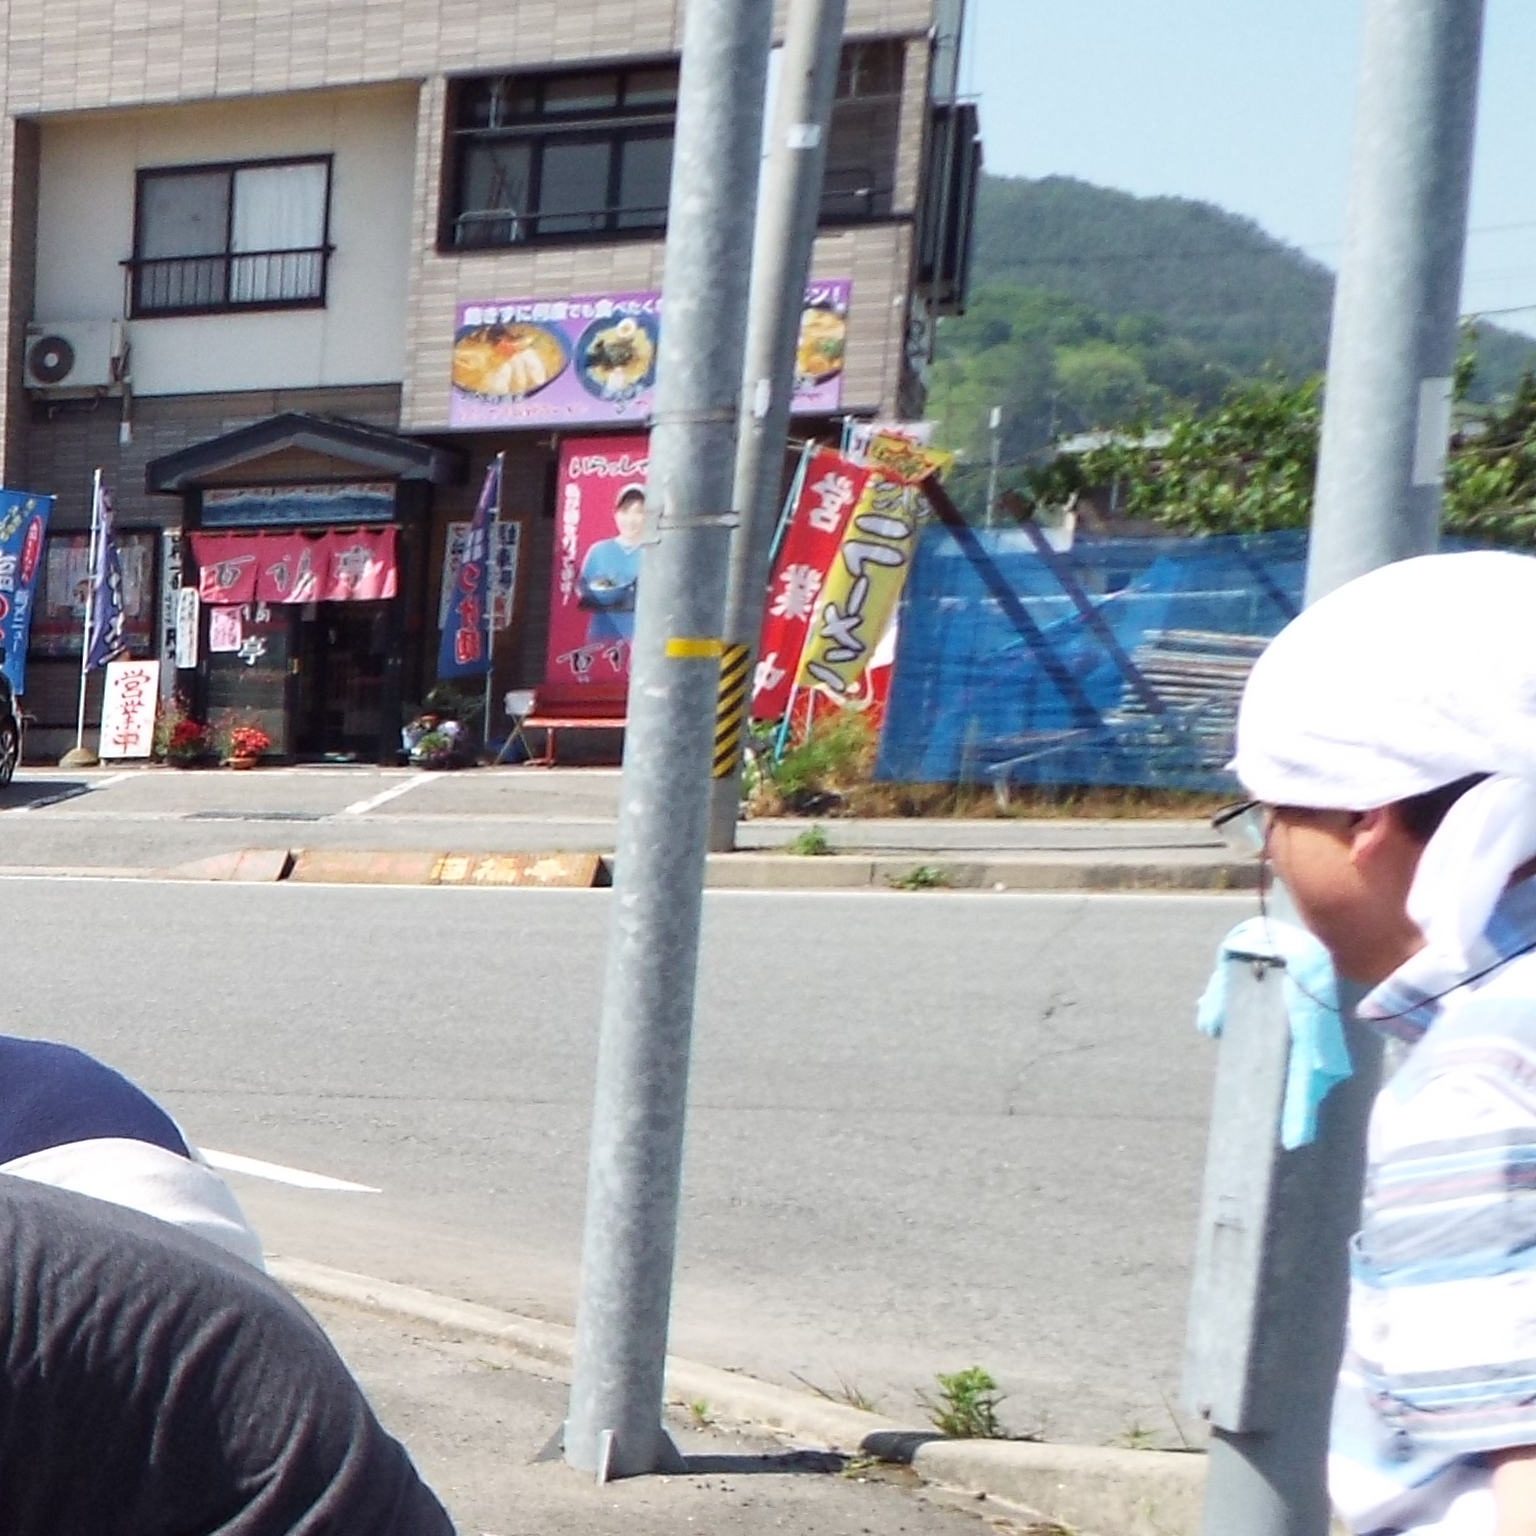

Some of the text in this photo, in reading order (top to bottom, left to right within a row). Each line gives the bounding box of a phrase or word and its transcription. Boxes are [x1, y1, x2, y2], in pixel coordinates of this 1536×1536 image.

[752, 471, 854, 699] 営業中
[113, 669, 151, 754] 営業中
